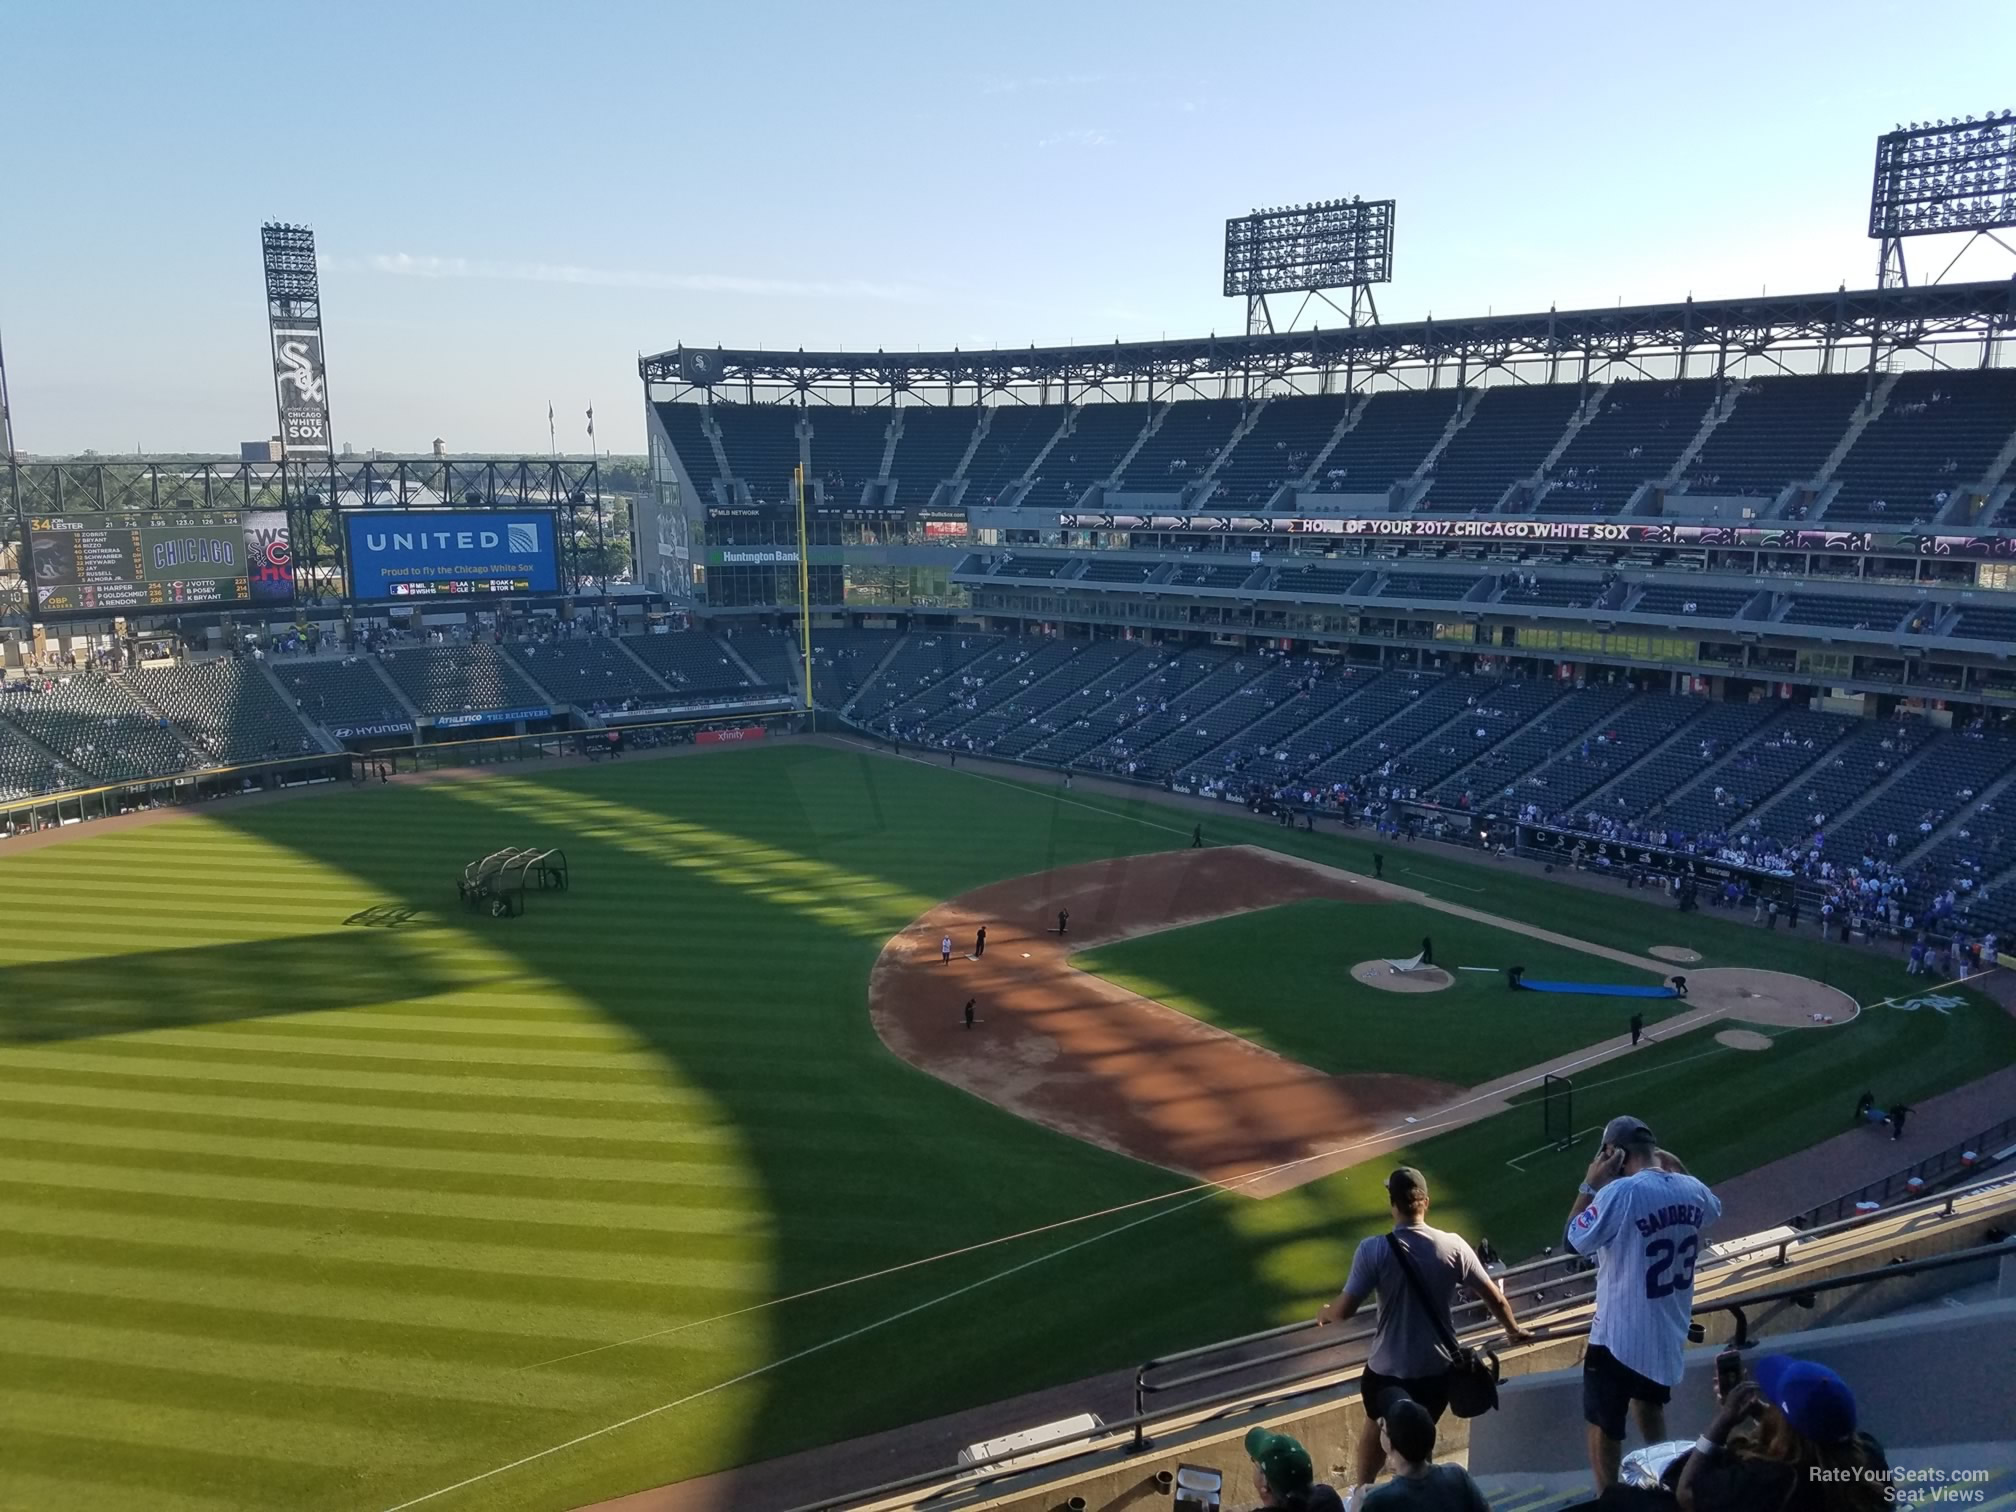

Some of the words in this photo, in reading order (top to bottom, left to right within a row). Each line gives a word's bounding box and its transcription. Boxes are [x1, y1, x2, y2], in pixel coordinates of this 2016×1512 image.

[288, 418, 322, 426] WHITE
[289, 426, 323, 438] SOX
[31, 519, 51, 531] 34
[1346, 520, 1366, 533] OF
[1370, 521, 1412, 534] YOUR
[1416, 522, 1450, 534] 2017
[1454, 522, 1528, 536] CHICAGO
[1534, 523, 1589, 538] WHITE
[1594, 525, 1630, 540] SOX
[367, 531, 499, 551] UNITED
[153, 538, 234, 569] CHICAGO
[723, 551, 774, 564] Huntington
[775, 550, 799, 561] Bank
[381, 568, 409, 576] Proud
[423, 566, 435, 576] fly
[438, 566, 452, 574] the
[454, 564, 488, 574] Chicago
[490, 564, 516, 572] White
[518, 564, 534, 572] Sox
[438, 714, 482, 724] ATHLETICO
[505, 709, 548, 719] RELIEVERS
[356, 723, 412, 736] HYUNDAI
[719, 730, 744, 740] xfinity
[1172, 784, 1190, 794] Modelo
[1226, 792, 1244, 803] Modelo
[1635, 1204, 1704, 1237] SANDBER
[1645, 1235, 1698, 1299] 23
